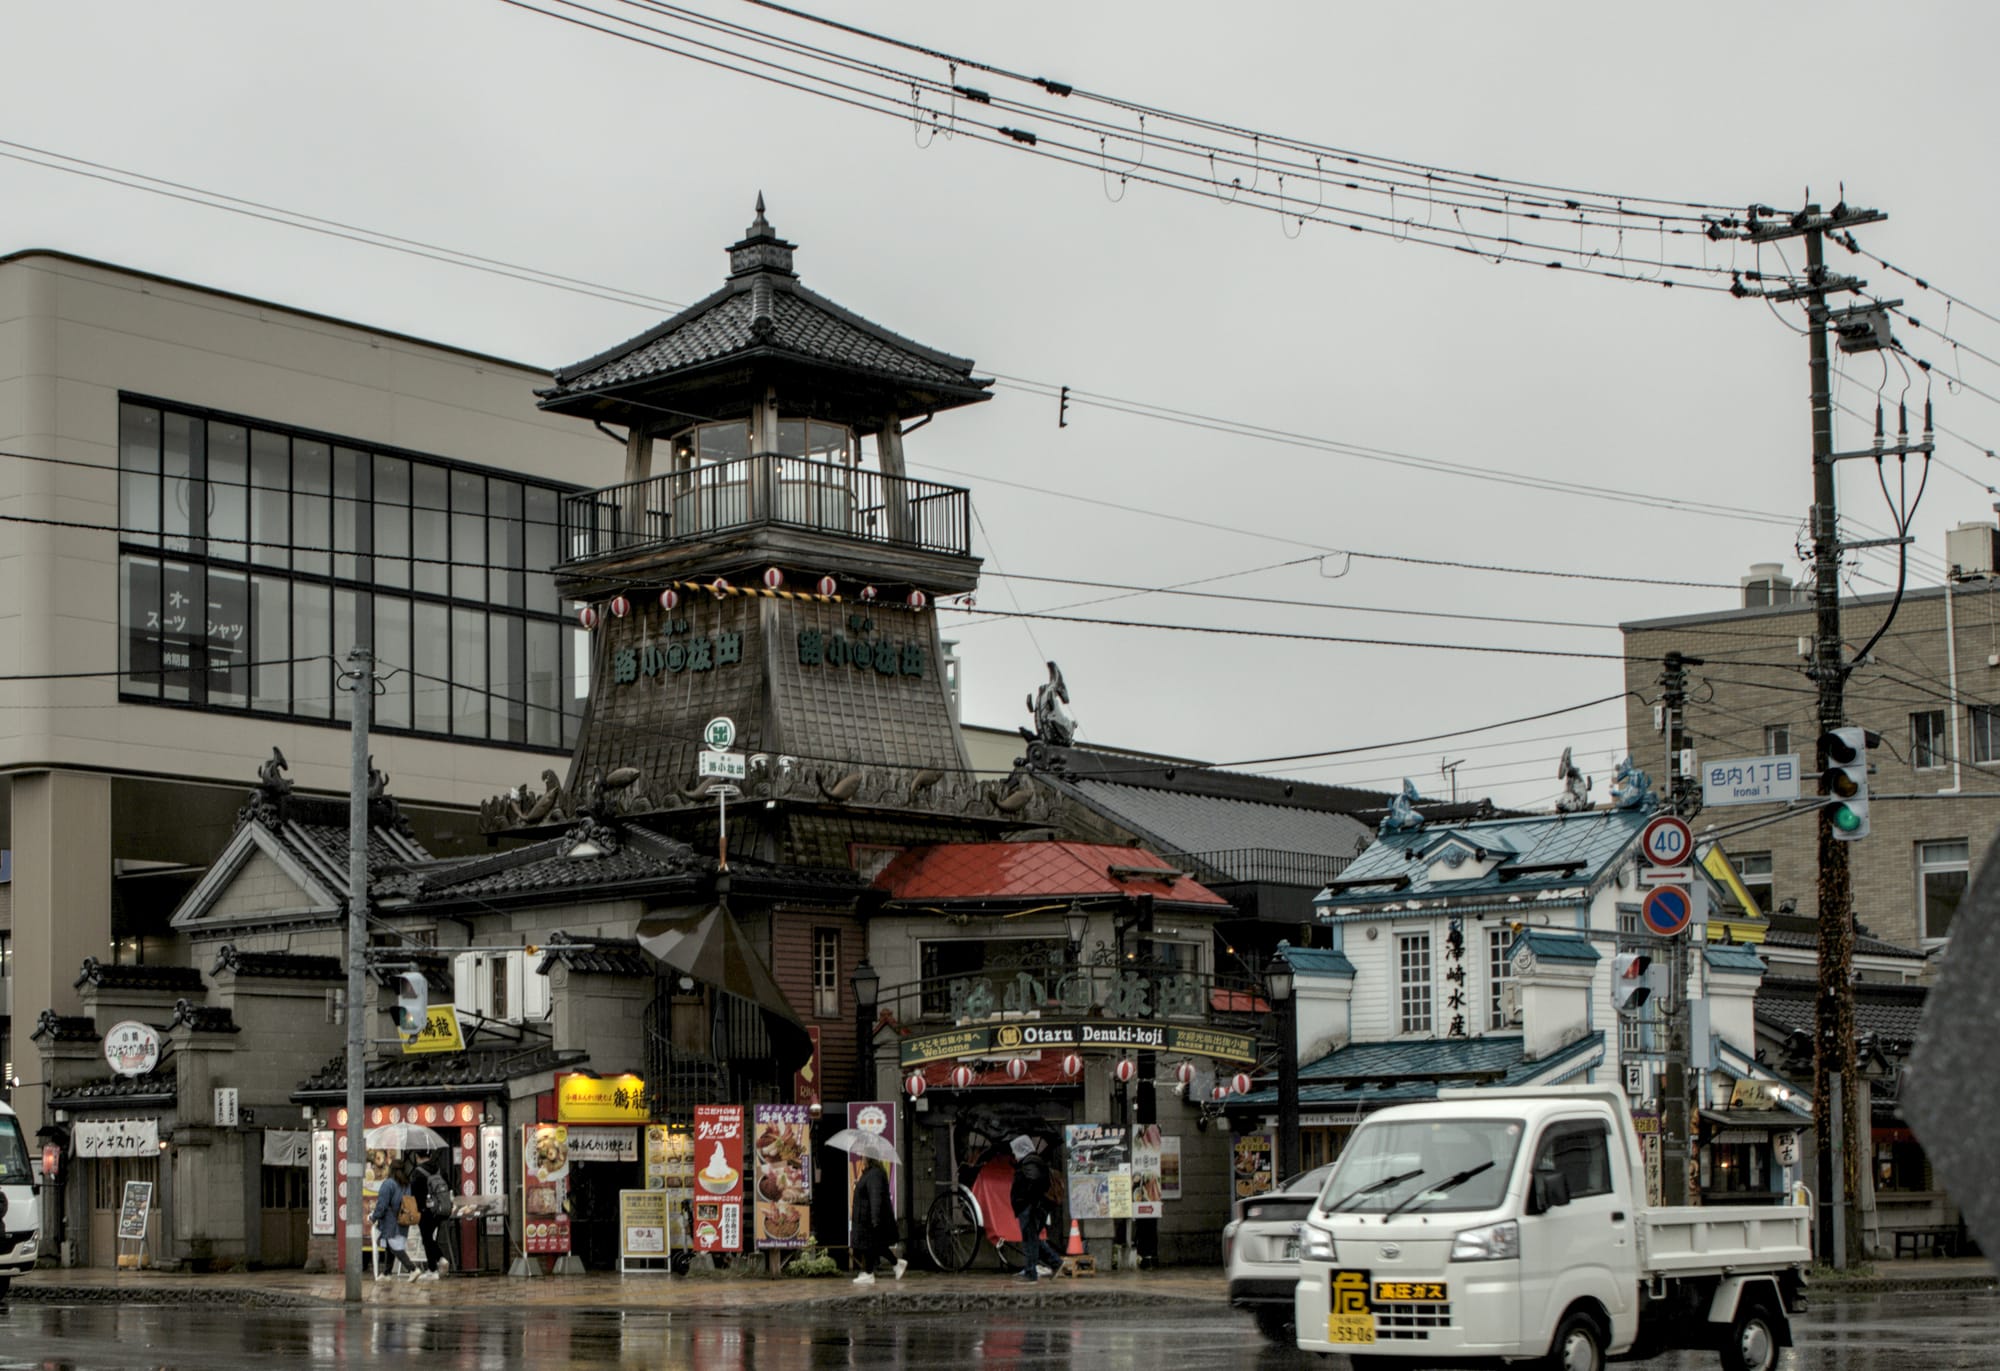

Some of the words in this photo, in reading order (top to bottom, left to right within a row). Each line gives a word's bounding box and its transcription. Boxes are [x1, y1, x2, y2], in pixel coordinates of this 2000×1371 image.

[169, 591, 221, 609] オーー
[147, 611, 186, 632] スーツ
[208, 620, 243, 640] シャツ
[1711, 762, 1792, 786] 色内1丁目
[1733, 786, 1760, 798] Ironai
[1764, 785, 1770, 794] 1
[1654, 830, 1681, 853] 40
[1024, 1026, 1073, 1043] Otaru
[1082, 1026, 1163, 1046] Denuki-koji
[922, 1042, 970, 1057] Welcome
[85, 1135, 147, 1150] ジンギスカン
[1332, 1271, 1370, 1314] 危
[1379, 1283, 1444, 1300] 高圧ガス
[1337, 1326, 1373, 1342] 59-06
